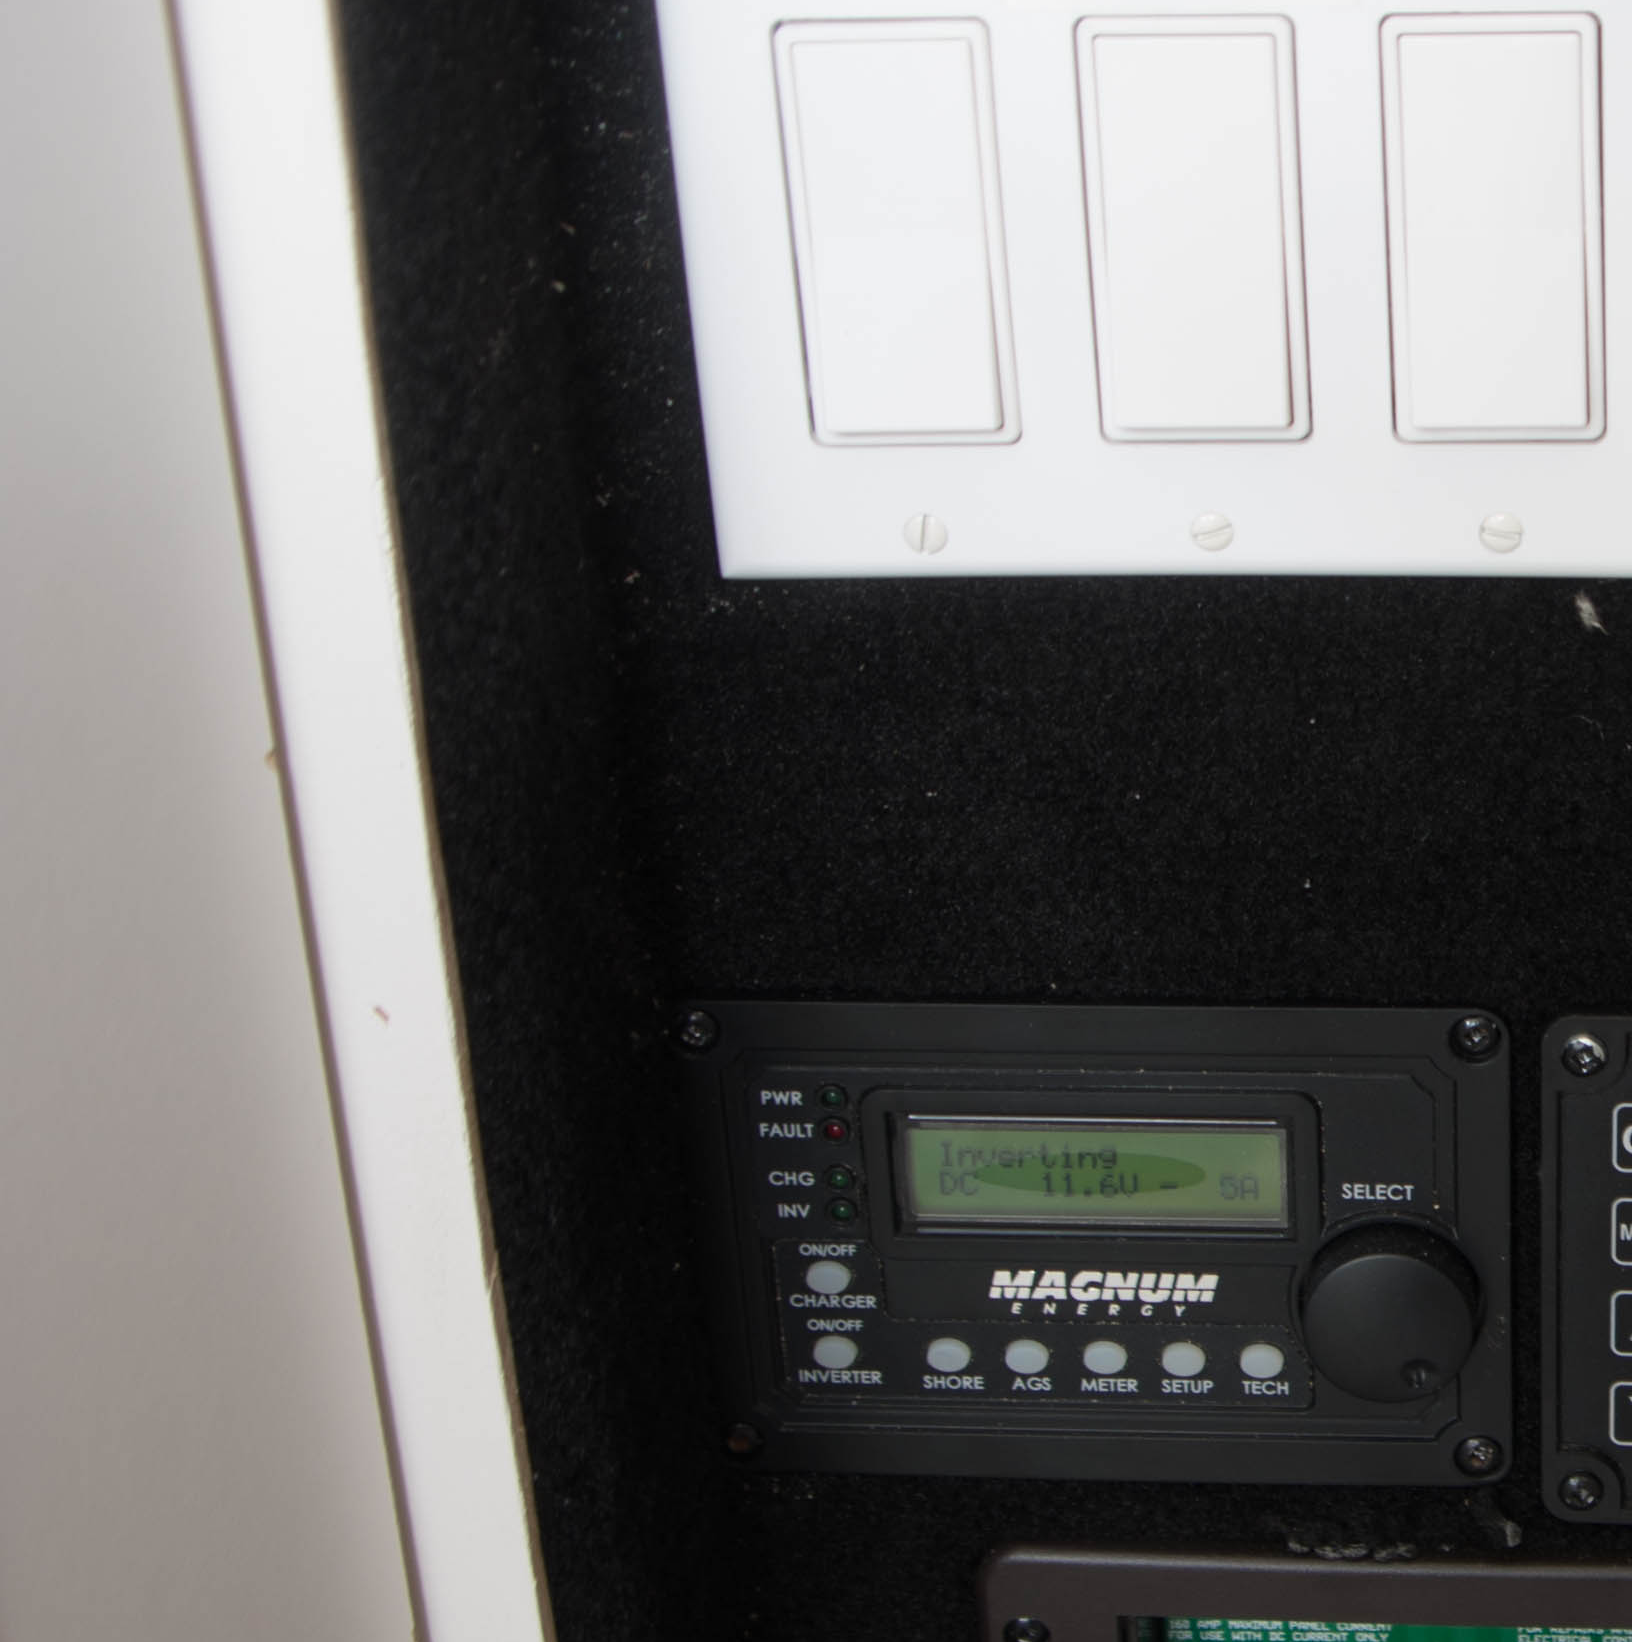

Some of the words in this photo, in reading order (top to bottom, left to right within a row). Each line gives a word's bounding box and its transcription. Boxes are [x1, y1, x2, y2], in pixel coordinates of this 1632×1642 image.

[760, 1089, 804, 1107] PWR
[759, 1122, 815, 1139] FAULT
[940, 1141, 1118, 1170] Inverting
[768, 1170, 817, 1187] CHG
[939, 1171, 979, 1195] DC
[1041, 1173, 1140, 1196] 11.6V
[1341, 1182, 1415, 1201] SELECT
[777, 1203, 811, 1219] INV
[798, 1243, 858, 1257] ON/OFF
[987, 1269, 1220, 1303] MAGNUM
[788, 1293, 878, 1309] CHARGER
[1010, 1301, 1187, 1318] ENERGY
[806, 1318, 864, 1334] ON/OFF
[798, 1368, 883, 1386] INVERTER
[921, 1375, 986, 1391] SHORE
[1010, 1376, 1053, 1393] AGS
[1080, 1378, 1140, 1393] METER
[1160, 1379, 1215, 1395] SETUP
[1241, 1380, 1291, 1397] TECH
[1168, 1630, 1193, 1641] FOR
[1199, 1631, 1226, 1641] USE
[1230, 1631, 1263, 1642] WITH
[1292, 1632, 1350, 1642] CURRENT
